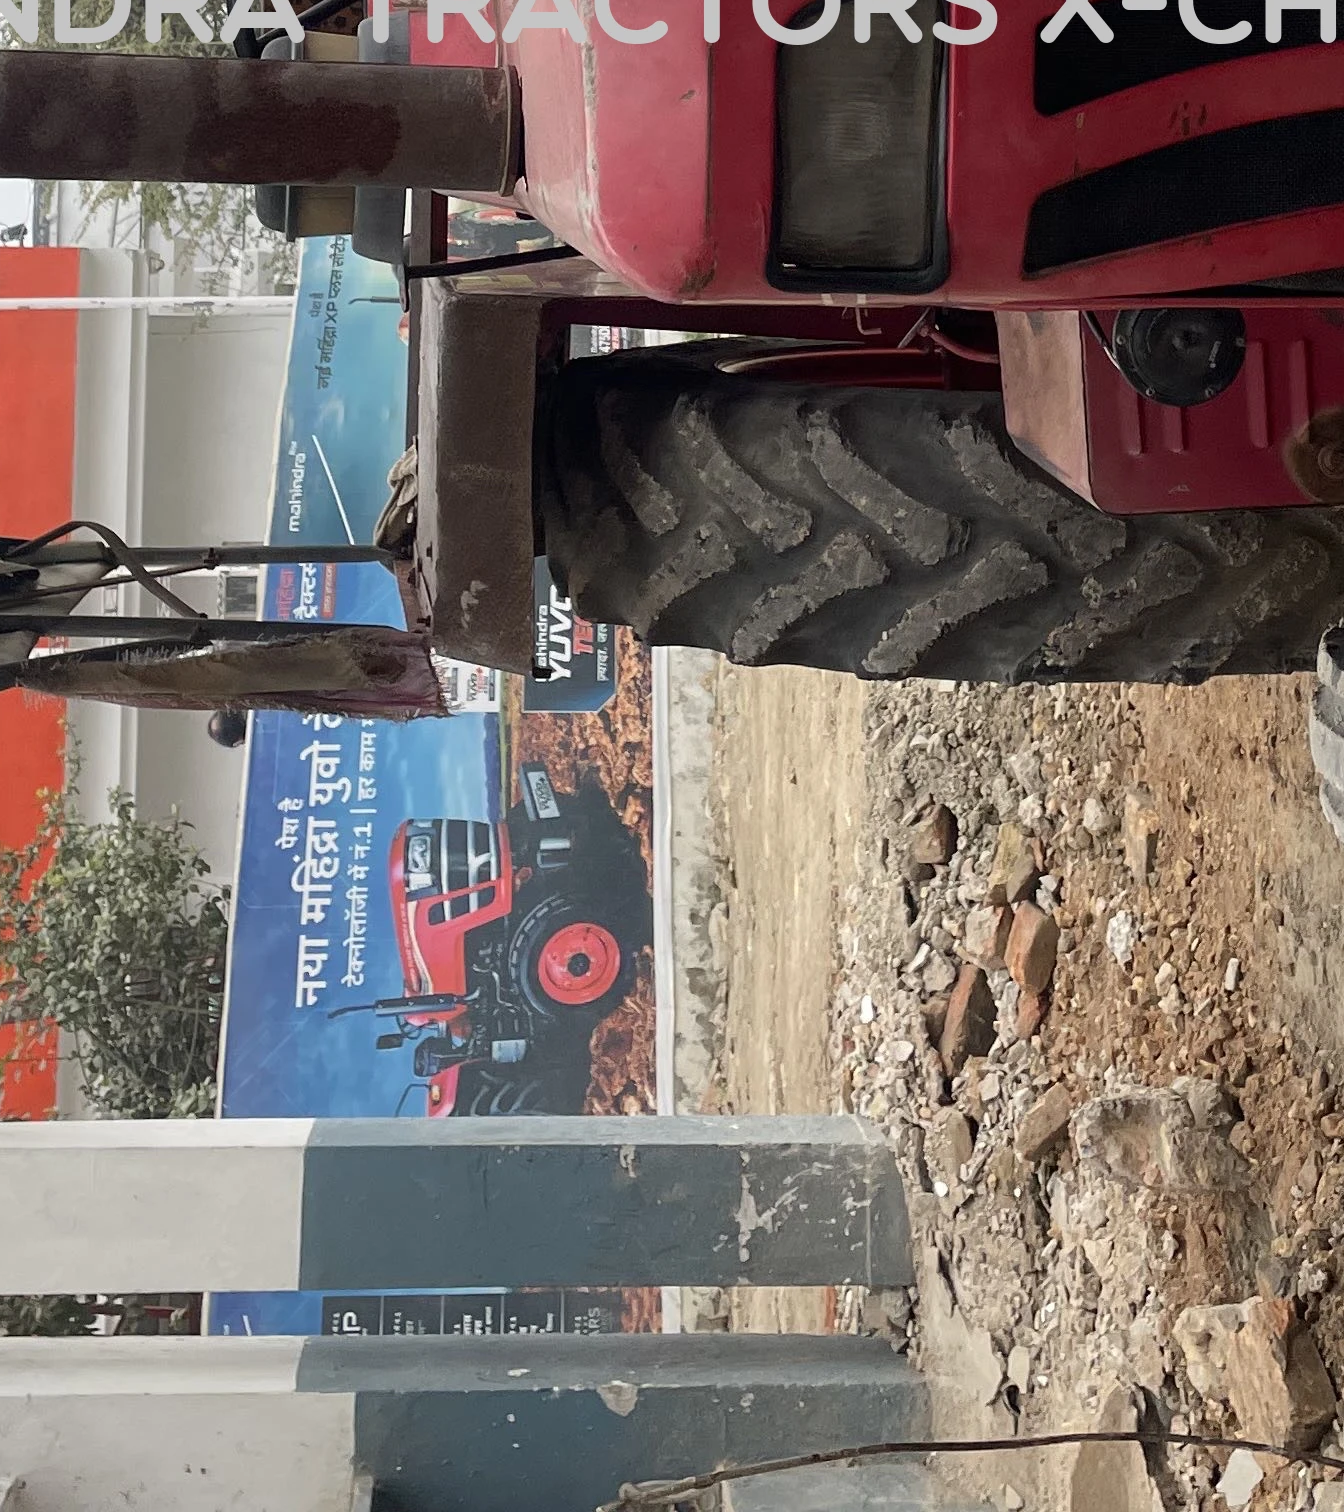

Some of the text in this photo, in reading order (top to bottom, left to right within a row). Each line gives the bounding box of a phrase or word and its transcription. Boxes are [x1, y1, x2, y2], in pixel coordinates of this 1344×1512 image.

[327, 269, 343, 300] प्लस
[324, 301, 338, 324] XP
[288, 452, 306, 532] mahindra
[300, 740, 352, 807] युवो
[359, 731, 376, 772] काम
[357, 777, 376, 801] हर
[275, 797, 304, 849] पेश है
[290, 816, 340, 925] महिंद्रा
[347, 862, 370, 881] में
[341, 886, 369, 987] टेक्नोलॉजी
[295, 934, 329, 1008] नया
